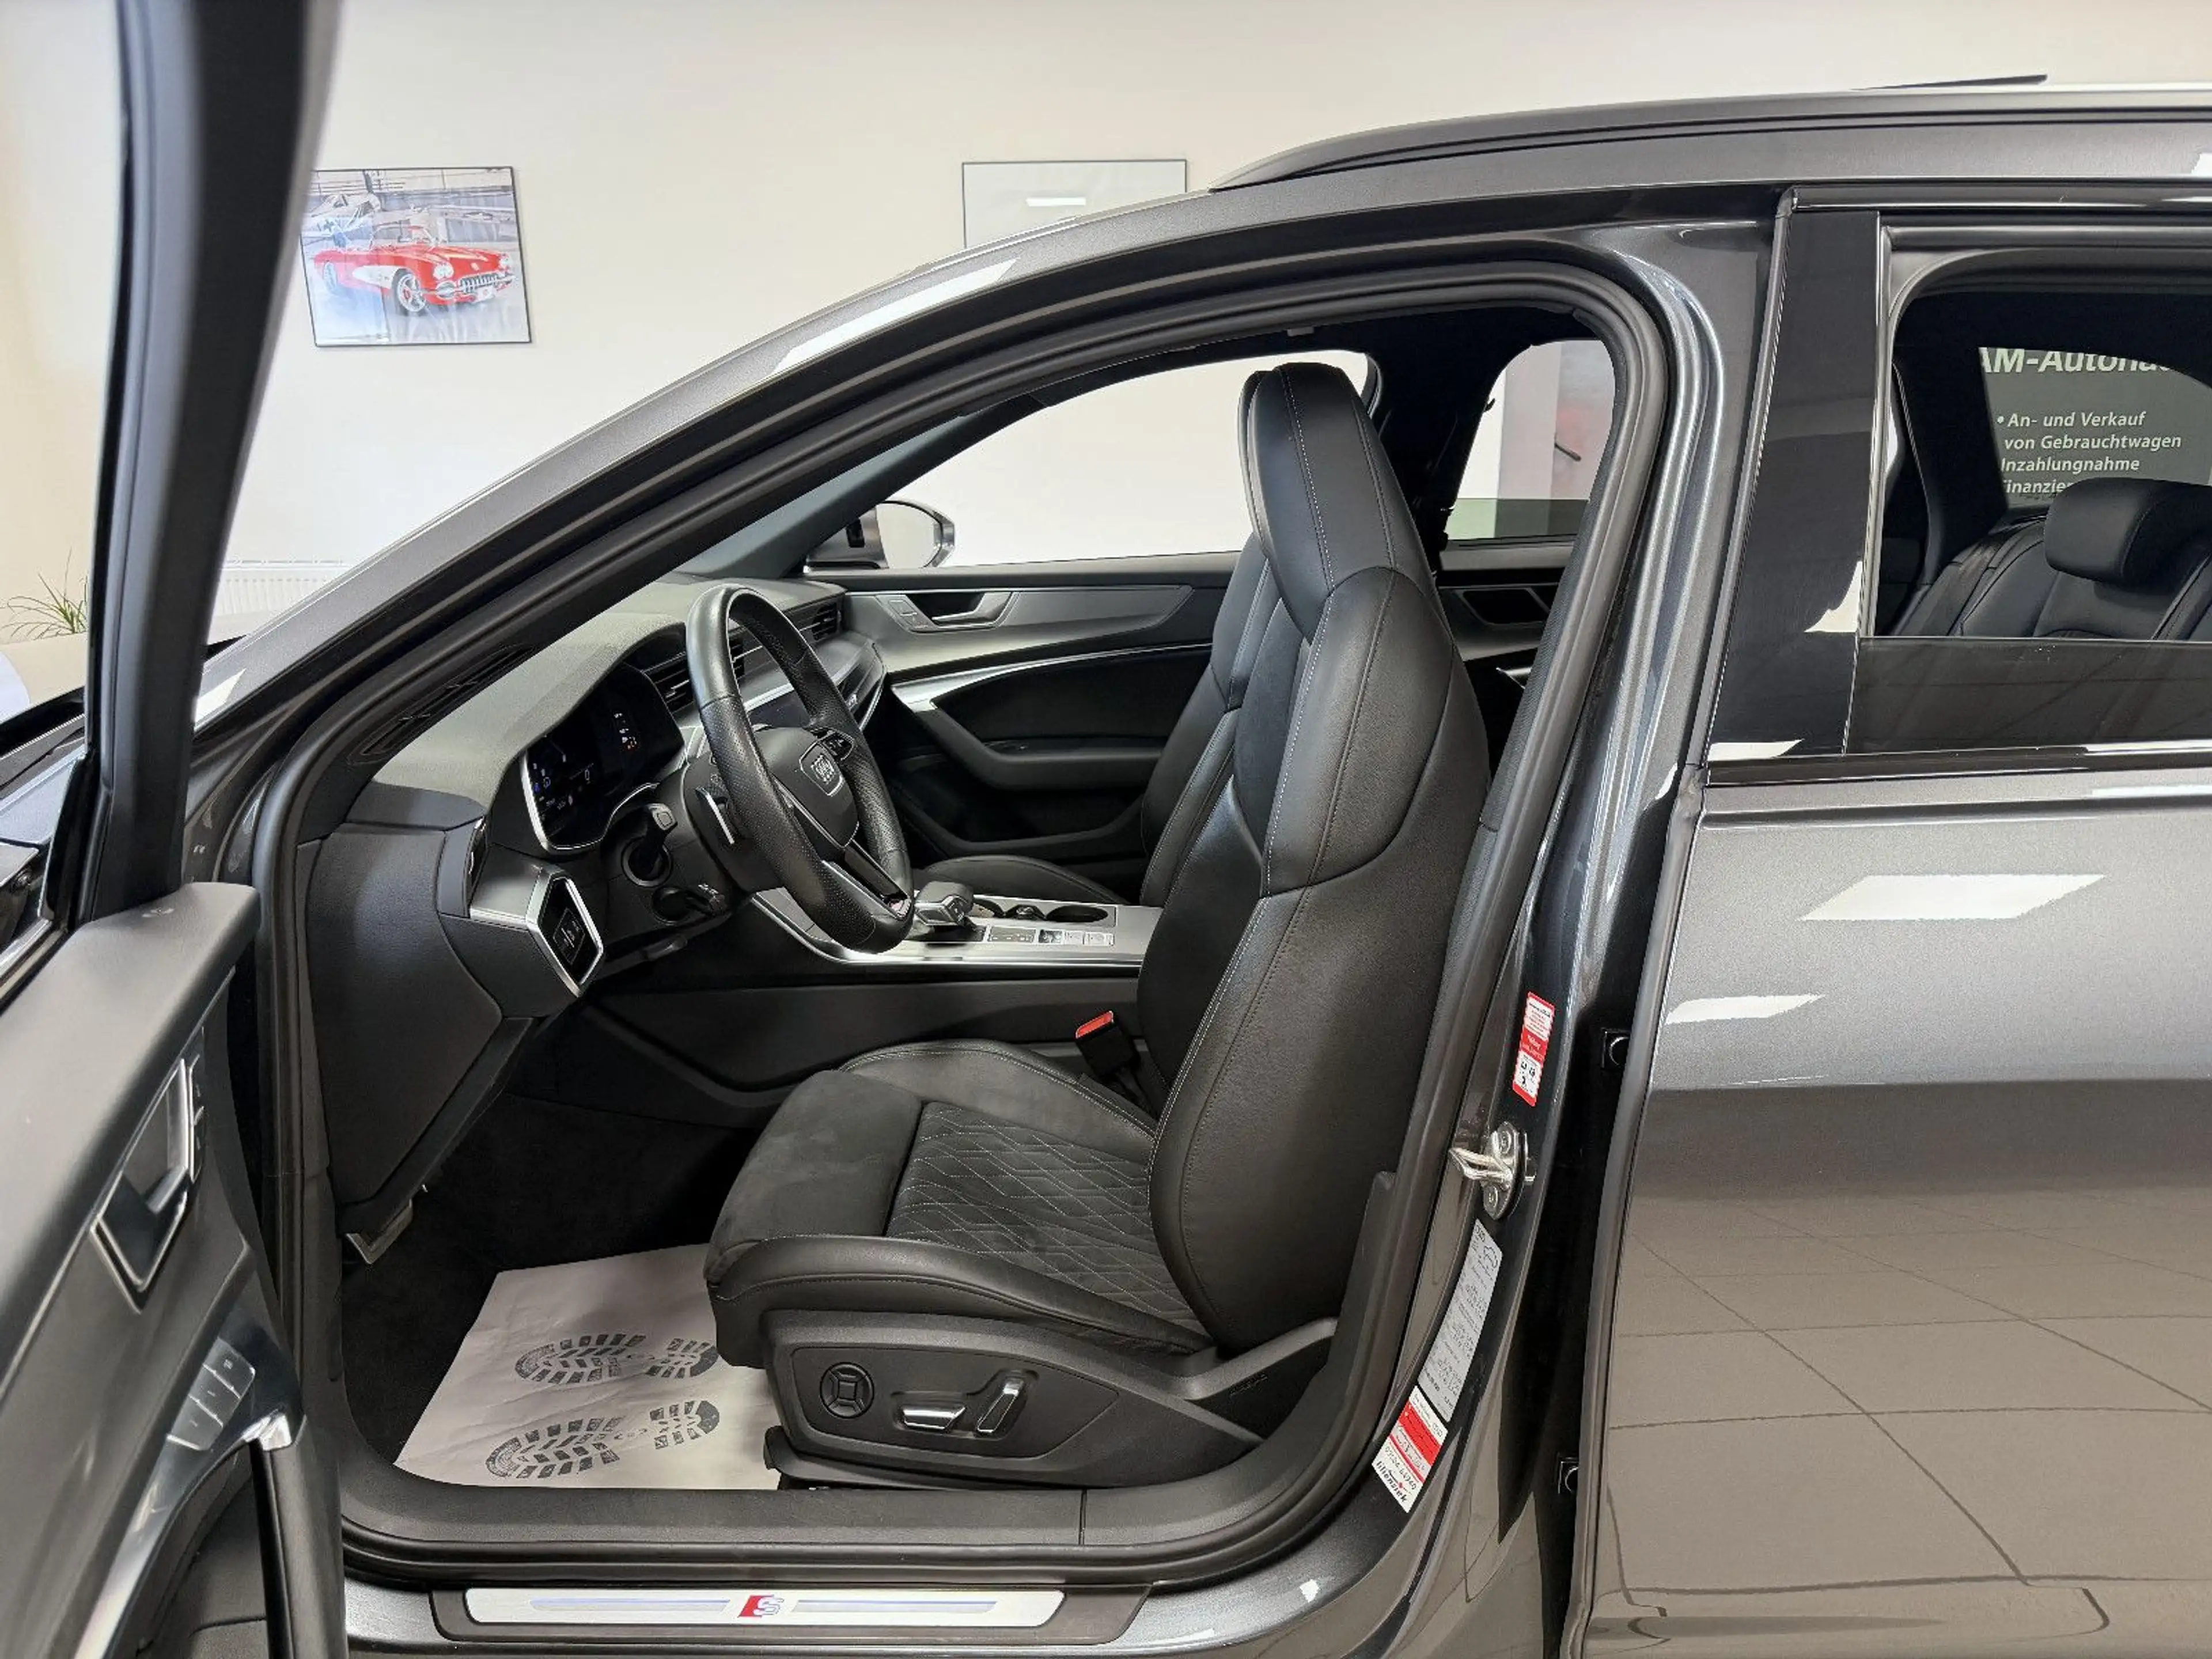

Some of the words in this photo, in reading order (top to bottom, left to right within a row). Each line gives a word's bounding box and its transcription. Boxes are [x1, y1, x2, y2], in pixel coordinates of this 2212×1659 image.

[1979, 347, 2170, 372] M-Autoa
[2008, 413, 2037, 427] An-
[2043, 412, 2075, 427] und
[2081, 411, 2146, 427] Verkauf
[2005, 439, 2035, 450] von
[2041, 434, 2182, 452] Gebrauchtwagen
[2001, 456, 2140, 475] Inzahlungnahme
[2003, 479, 2074, 494] inanzie
